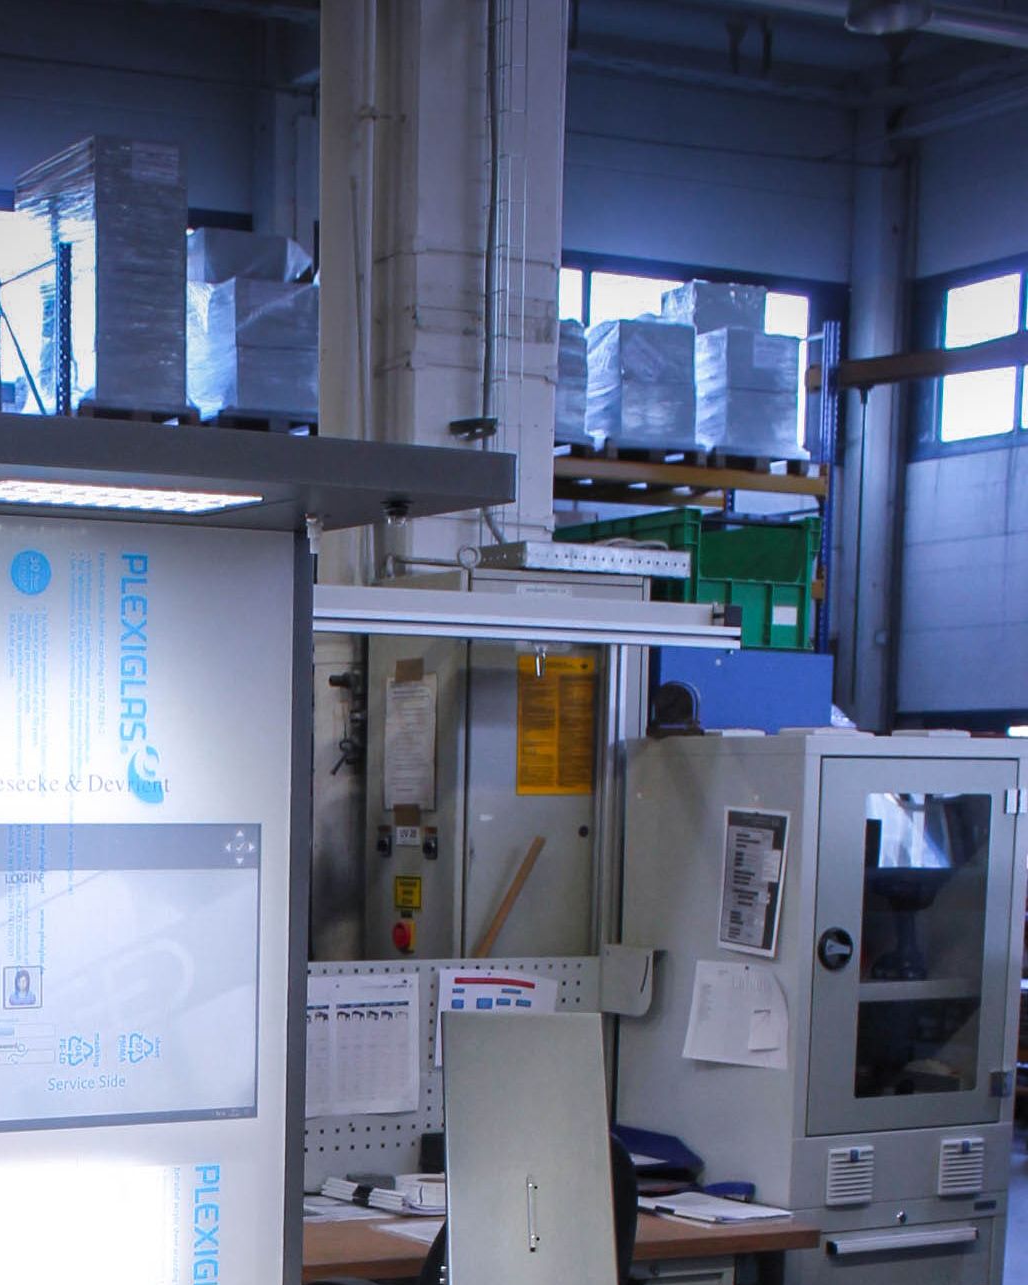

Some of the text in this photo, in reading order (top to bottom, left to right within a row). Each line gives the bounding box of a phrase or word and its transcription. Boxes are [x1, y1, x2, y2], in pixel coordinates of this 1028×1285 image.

[121, 553, 147, 742] PLEXIGLAS
[65, 775, 83, 795] &
[89, 773, 170, 795] Devrient
[5, 871, 43, 885] LOGIN
[48, 1074, 126, 1091] Service Side
